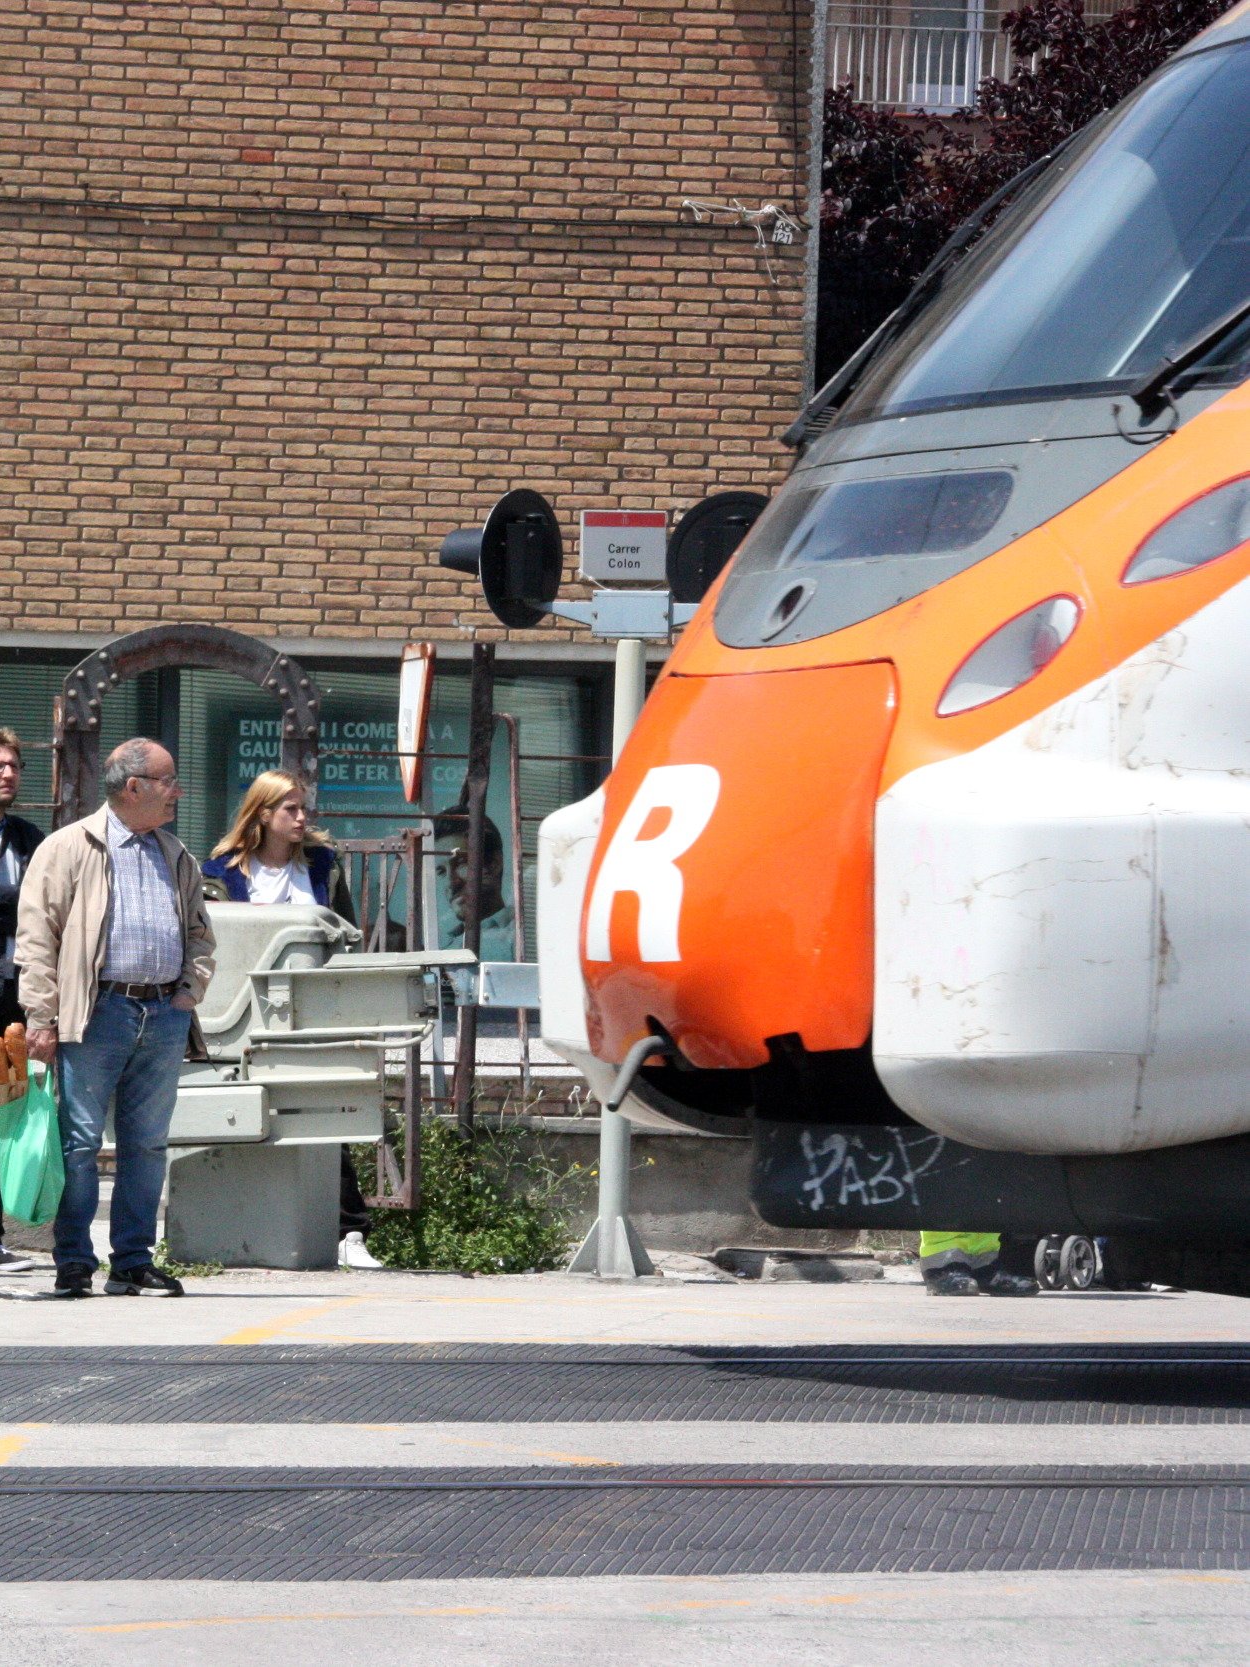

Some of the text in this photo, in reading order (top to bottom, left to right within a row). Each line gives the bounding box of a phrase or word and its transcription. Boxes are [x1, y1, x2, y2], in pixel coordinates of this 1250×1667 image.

[774, 232, 791, 244] 121
[607, 543, 641, 554] Carrer
[608, 558, 641, 568] Colon
[325, 764, 350, 780] DE
[355, 765, 389, 781] FER
[586, 763, 721, 963] R
